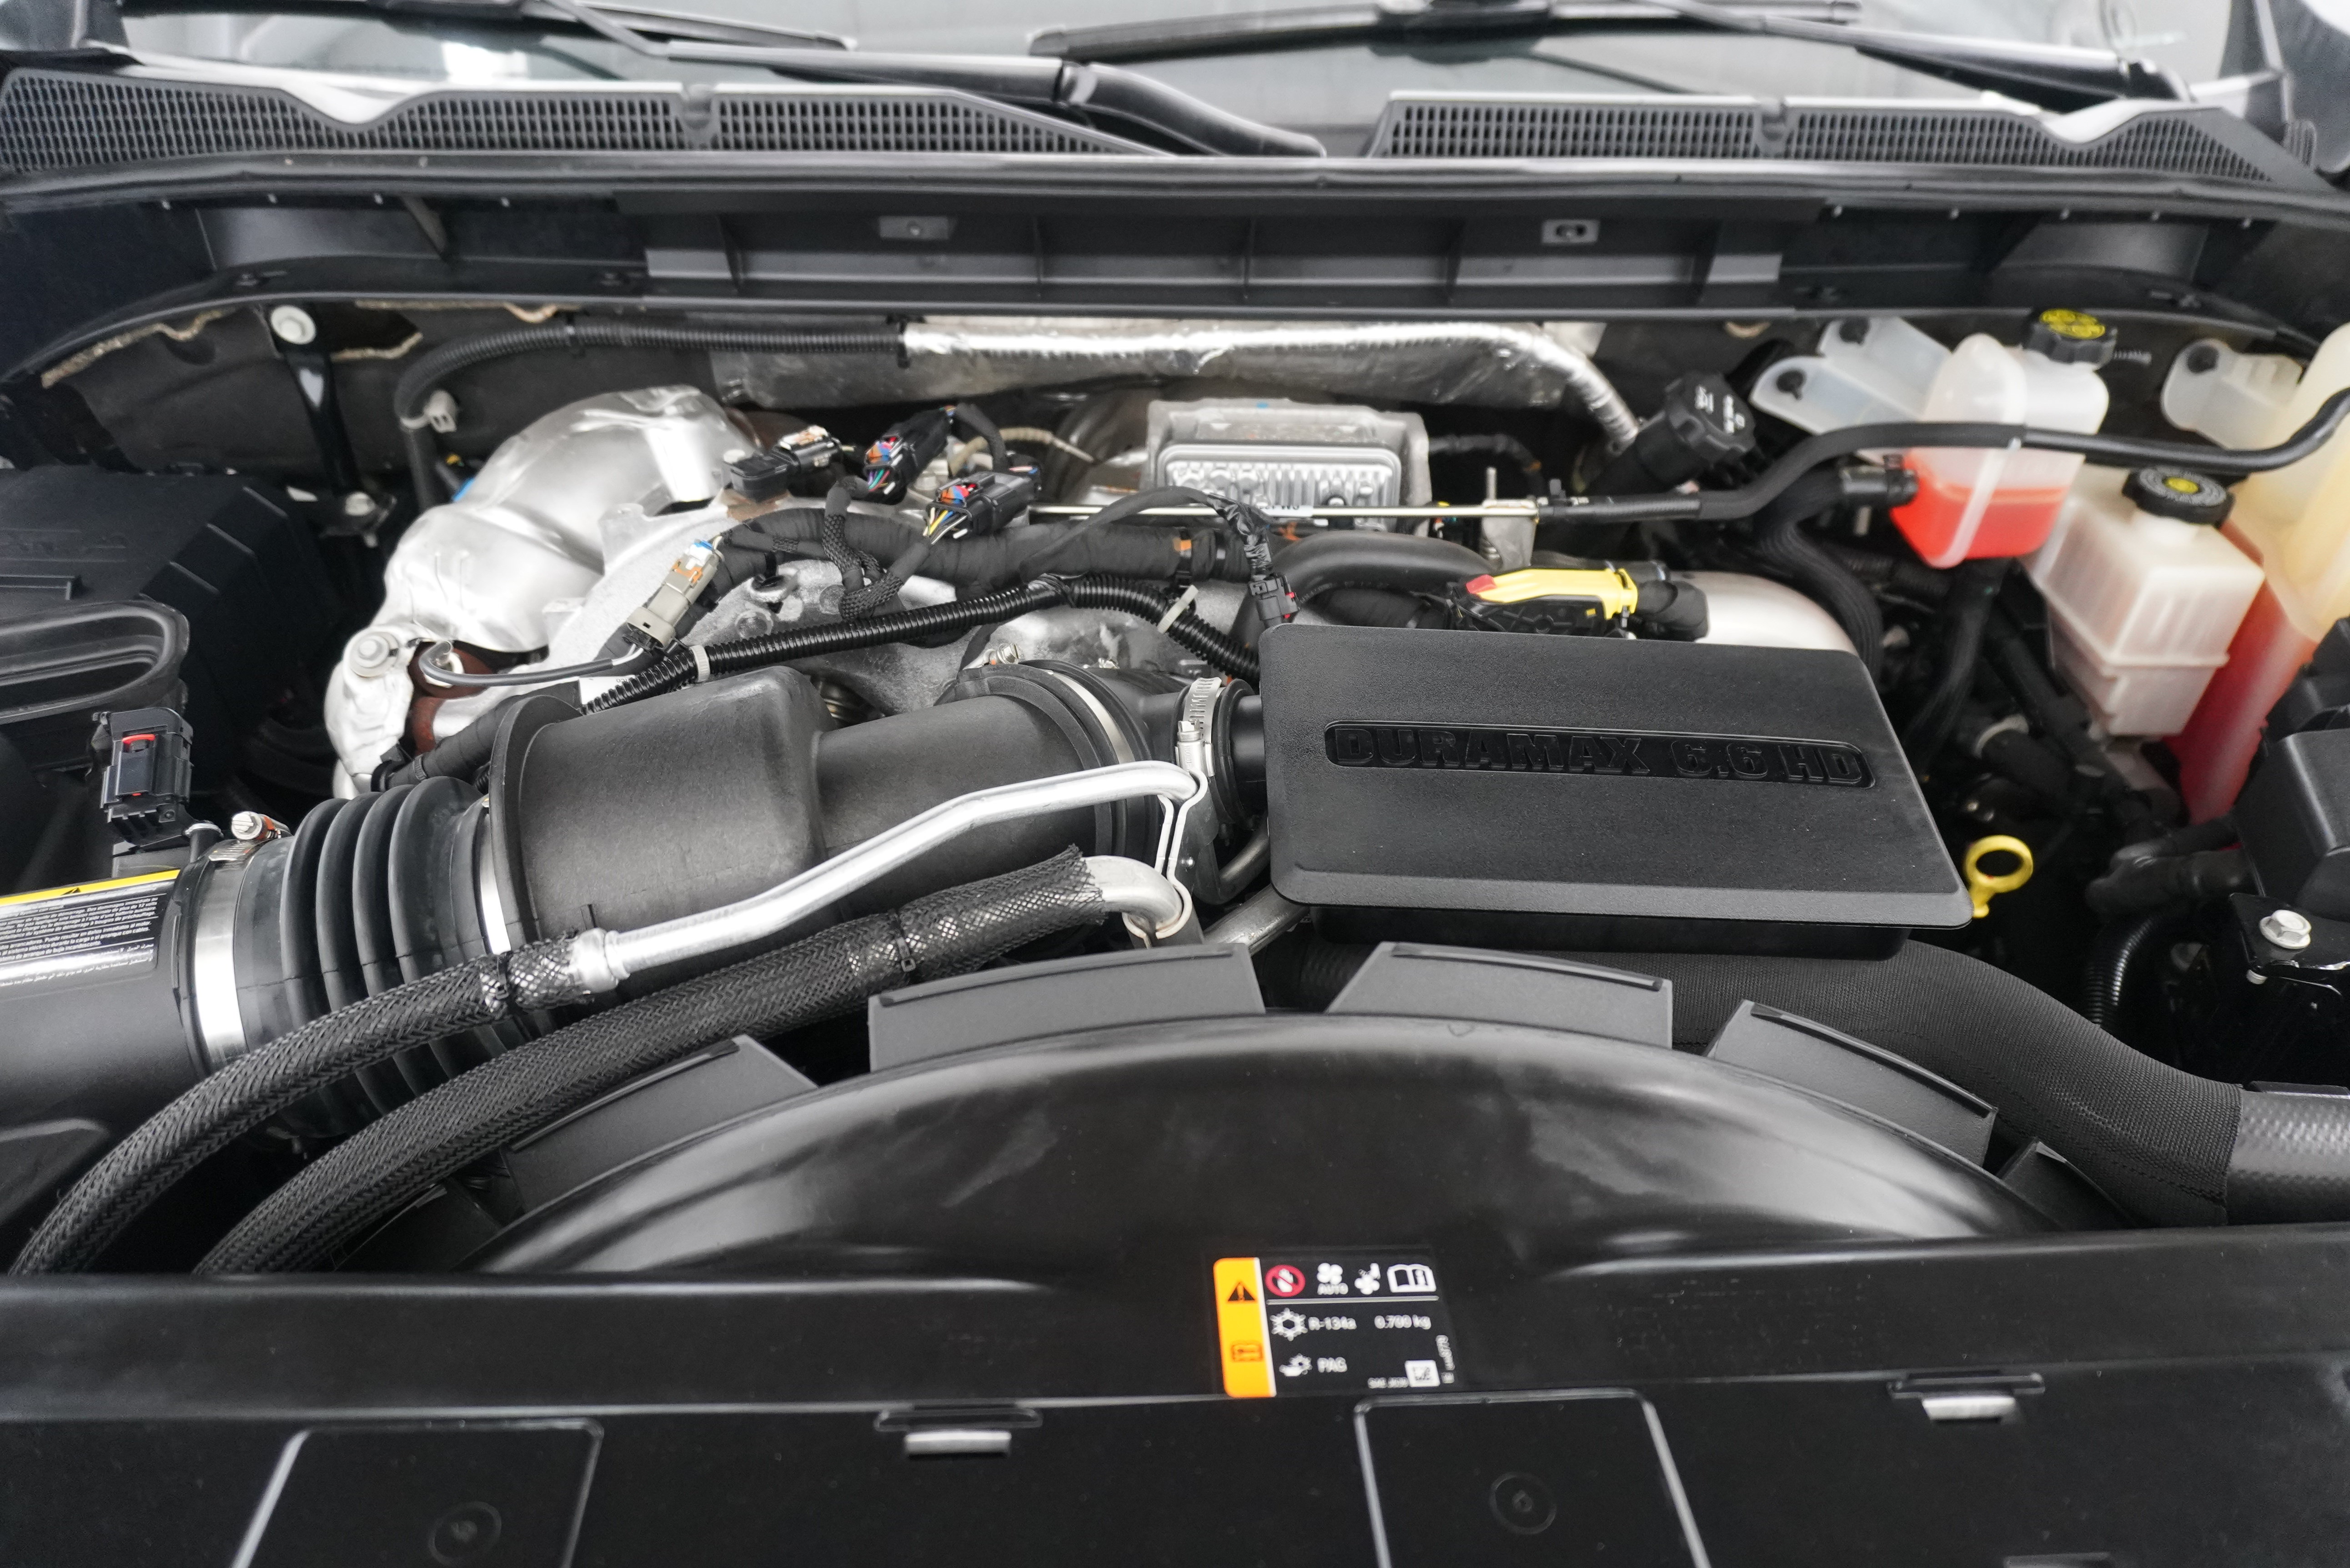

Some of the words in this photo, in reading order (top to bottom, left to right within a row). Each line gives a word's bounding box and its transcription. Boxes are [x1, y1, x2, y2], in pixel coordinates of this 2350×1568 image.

[1334, 728, 1652, 774] DURAMAX
[1670, 738, 1770, 779] 6.6
[1783, 745, 1865, 783] HD
[1317, 1282, 1348, 1295] AUTO
[1308, 1316, 1357, 1331] R-134a
[1412, 1314, 1431, 1330] kg
[1317, 1357, 1348, 1373] PAG
